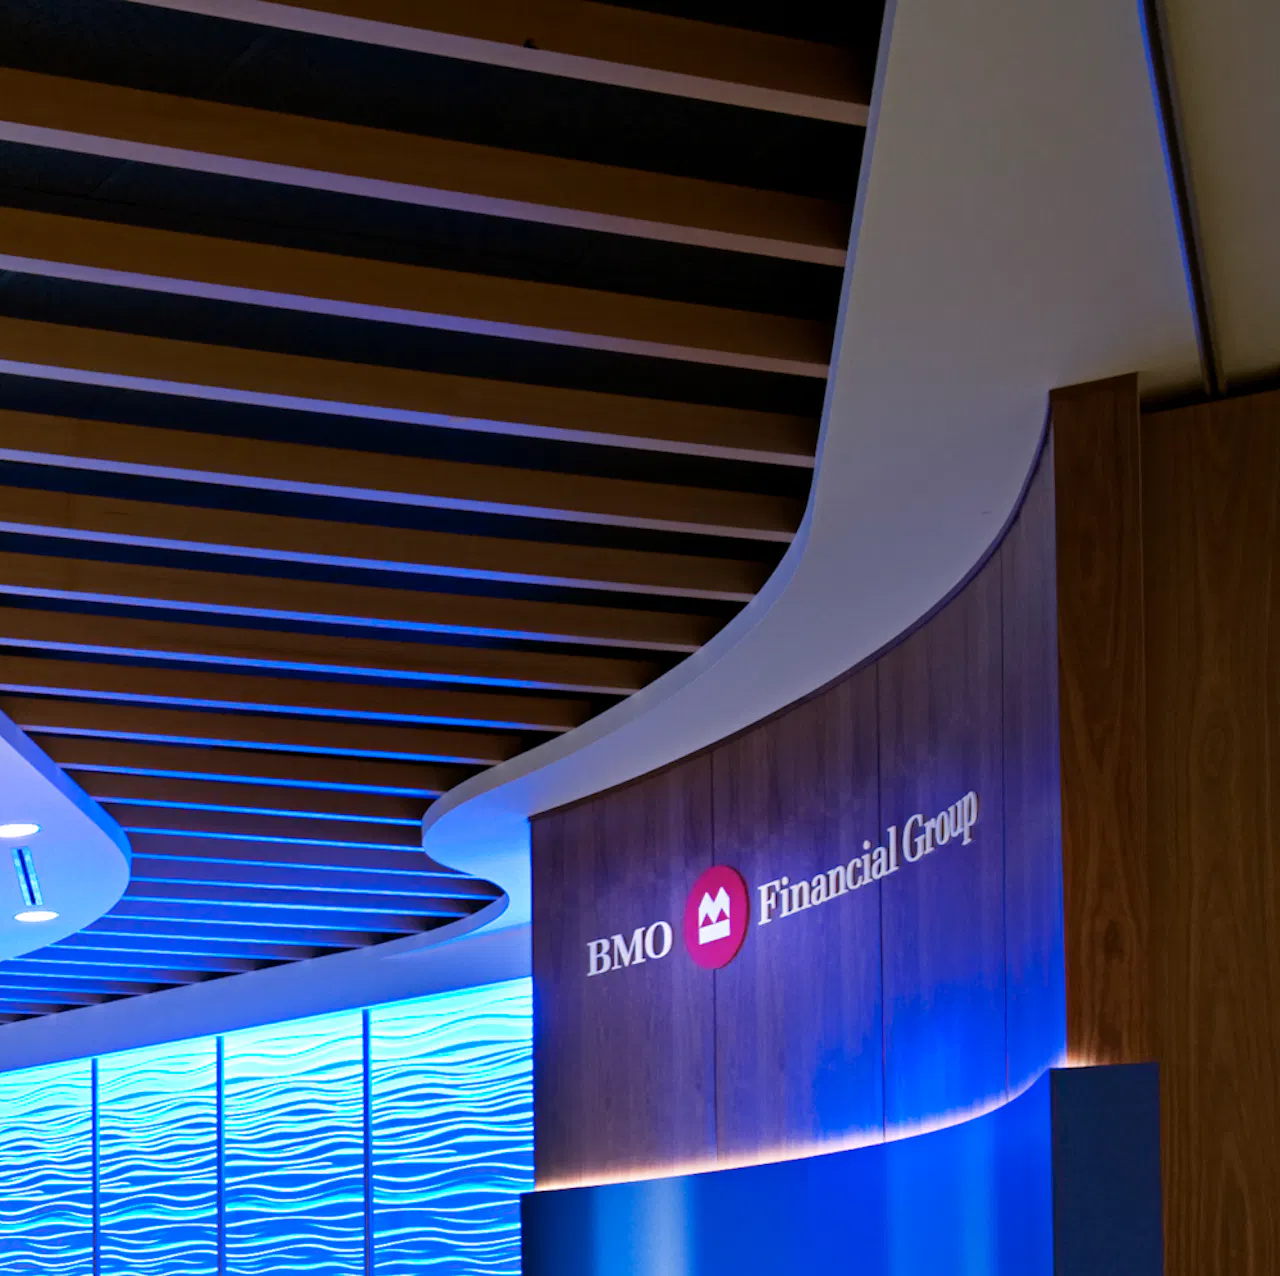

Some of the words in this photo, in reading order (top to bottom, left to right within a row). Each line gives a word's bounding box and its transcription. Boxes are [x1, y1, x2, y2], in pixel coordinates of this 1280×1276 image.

[587, 921, 673, 976] BMO
[757, 826, 898, 925] Financial
[902, 790, 979, 862] Group
